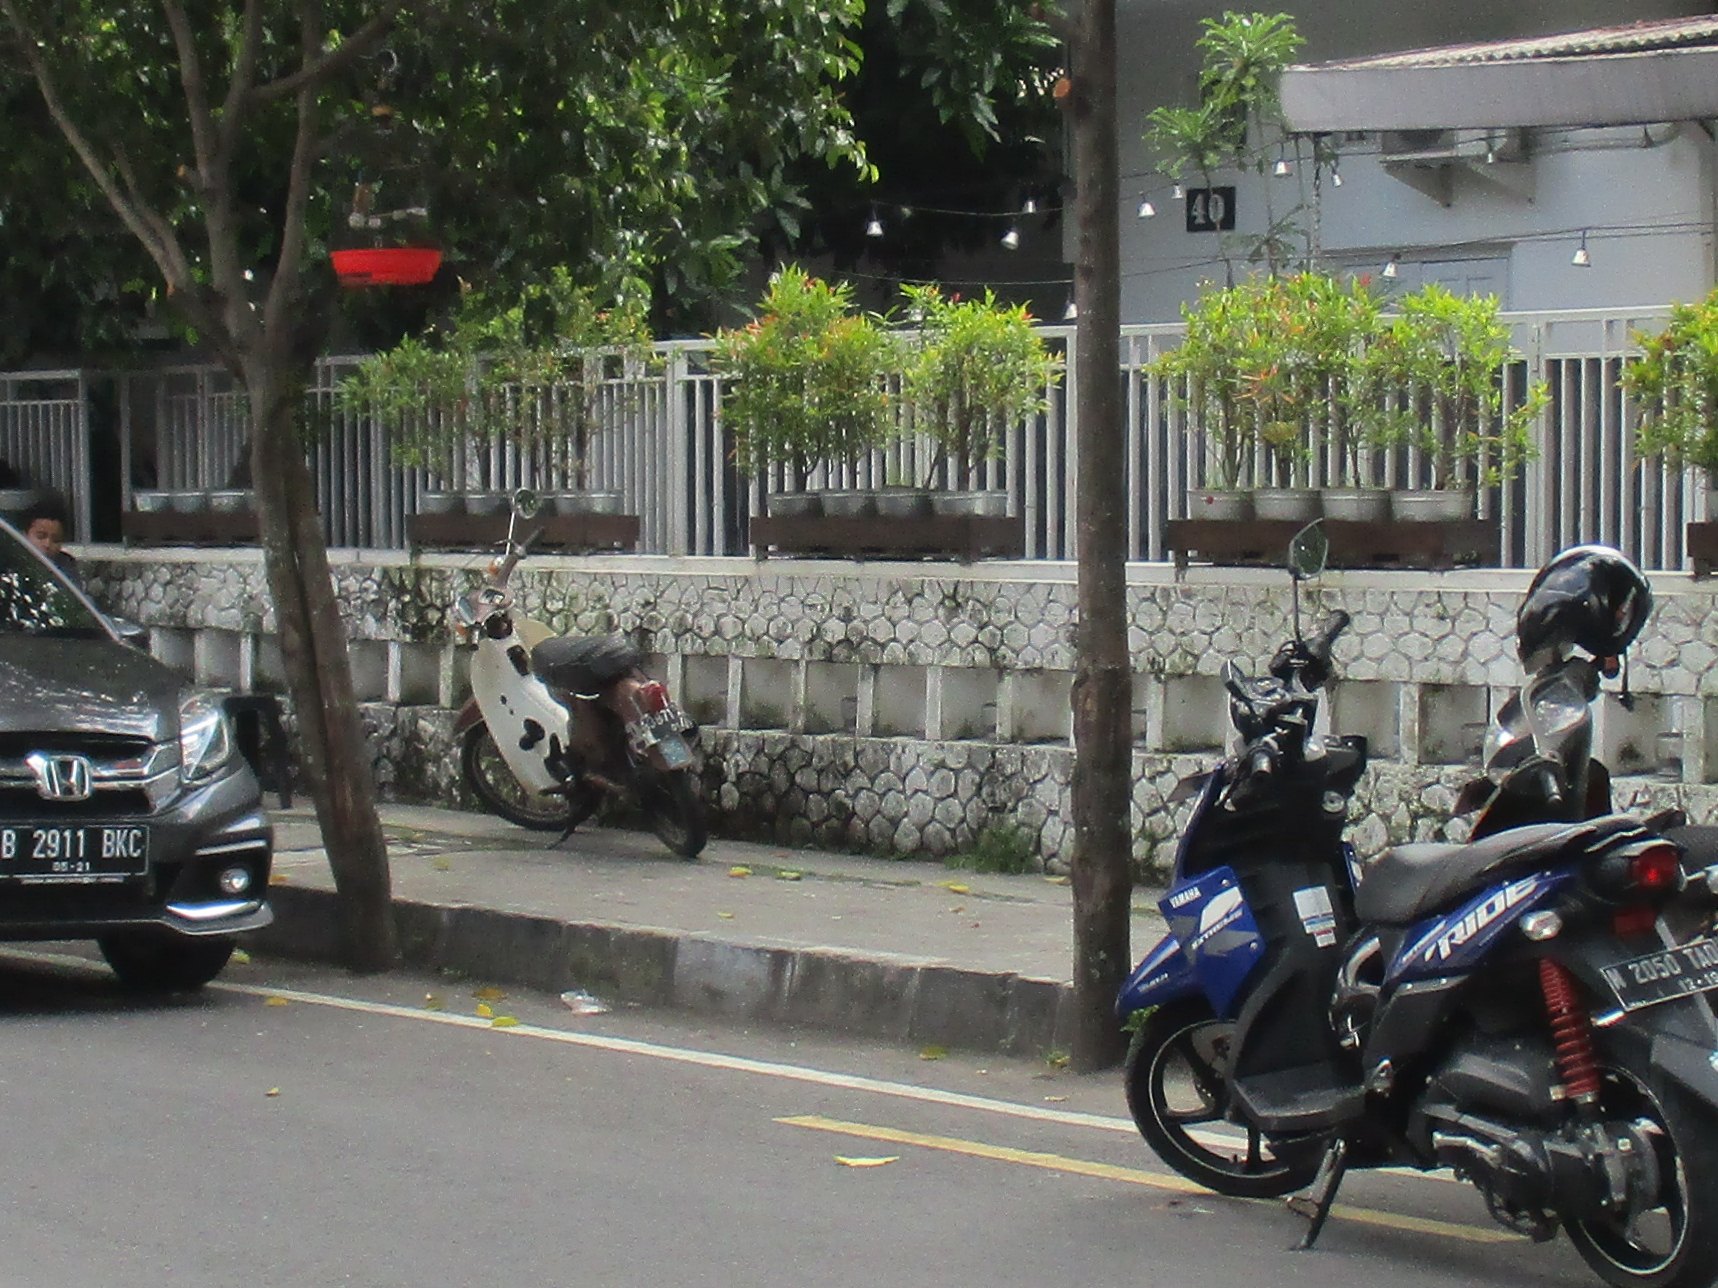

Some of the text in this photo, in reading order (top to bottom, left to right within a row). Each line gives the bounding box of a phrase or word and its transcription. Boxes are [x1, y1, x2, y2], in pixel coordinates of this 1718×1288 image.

[1, 829, 143, 859] B 2911 BKC
[1627, 953, 1683, 985] 2050
